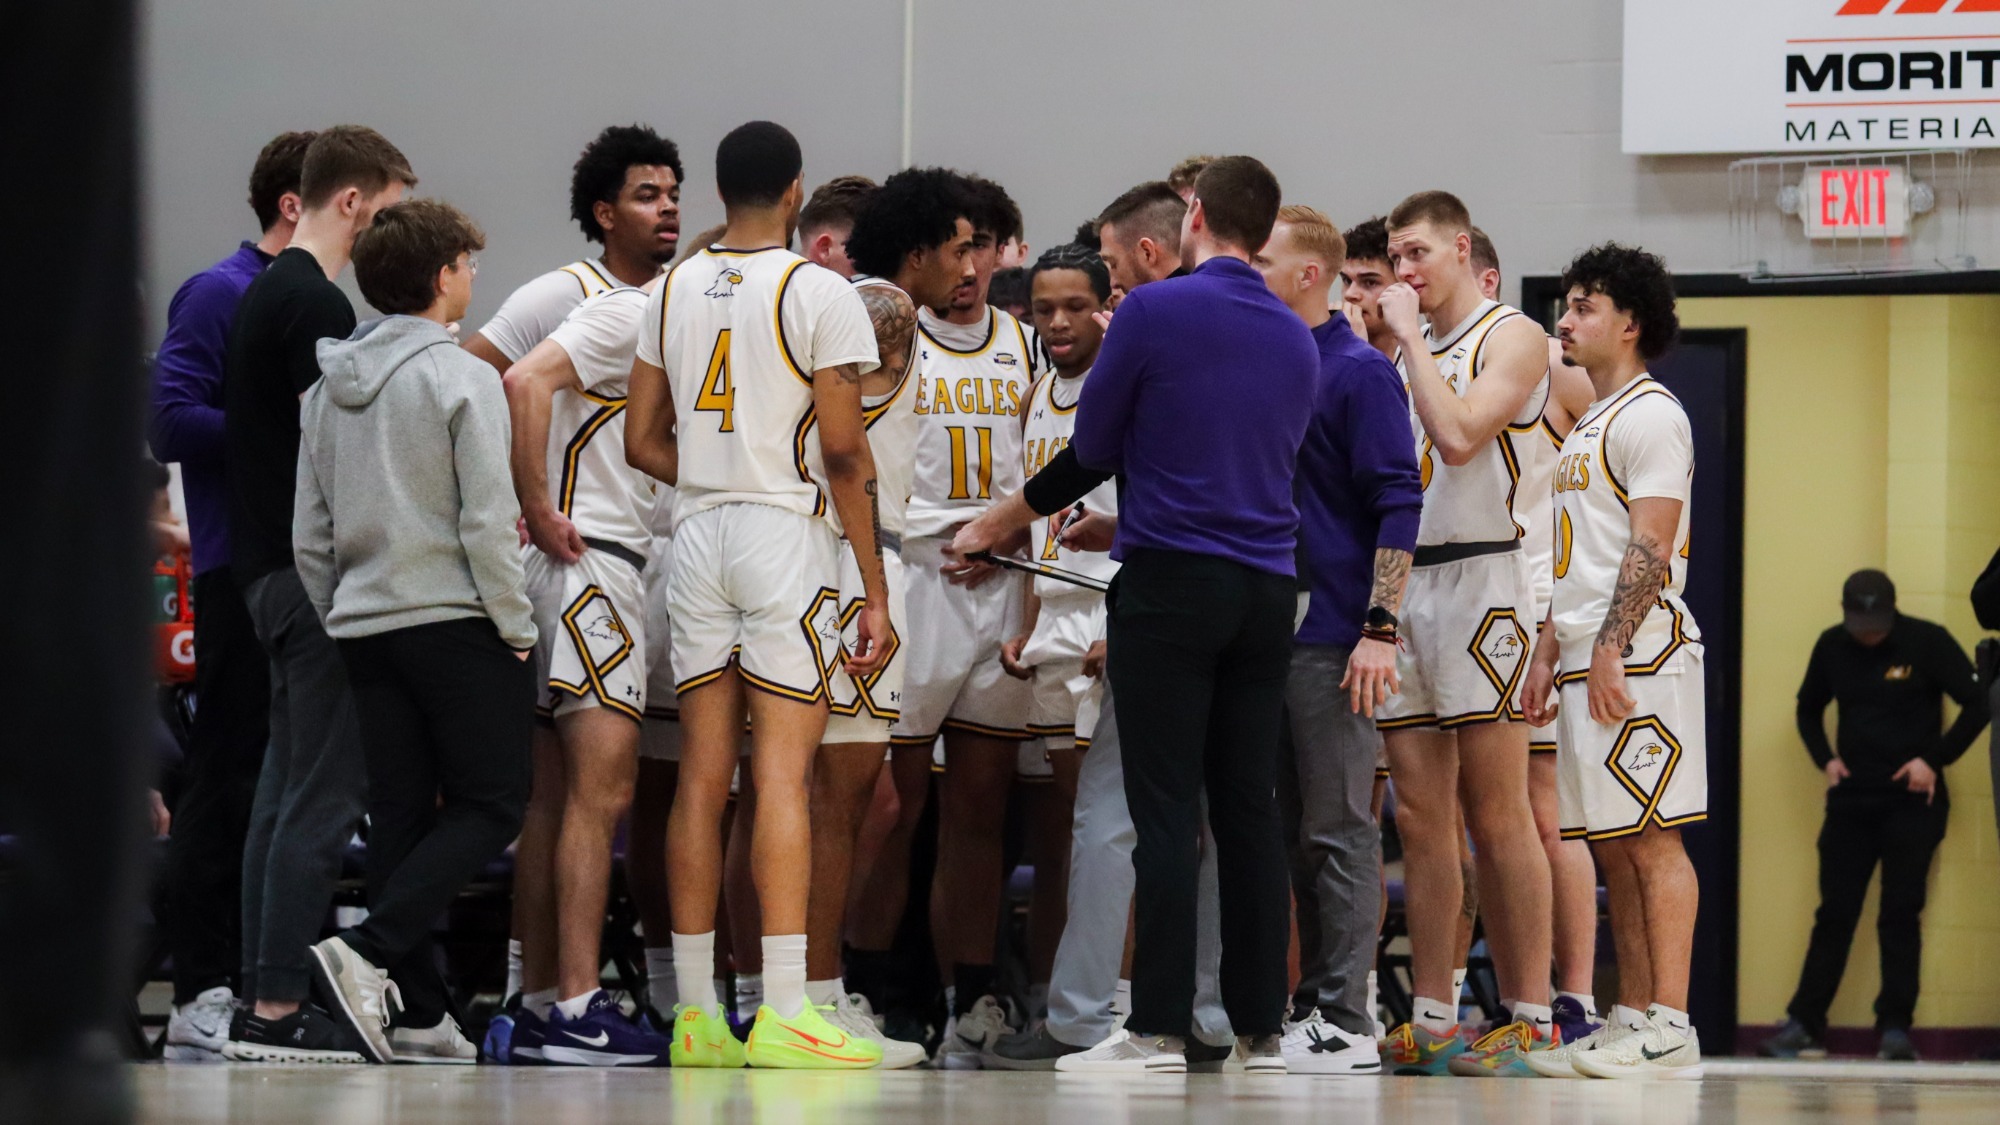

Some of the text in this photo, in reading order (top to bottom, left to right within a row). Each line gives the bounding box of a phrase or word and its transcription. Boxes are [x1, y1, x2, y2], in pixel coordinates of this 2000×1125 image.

[1786, 51, 2000, 92] MORIT
[1786, 117, 1995, 141] MATERIA
[1820, 169, 1890, 226] EXIT
[694, 328, 736, 433] 4
[914, 375, 1020, 417] EAGLES
[944, 426, 993, 500] 11
[171, 629, 196, 665] G
